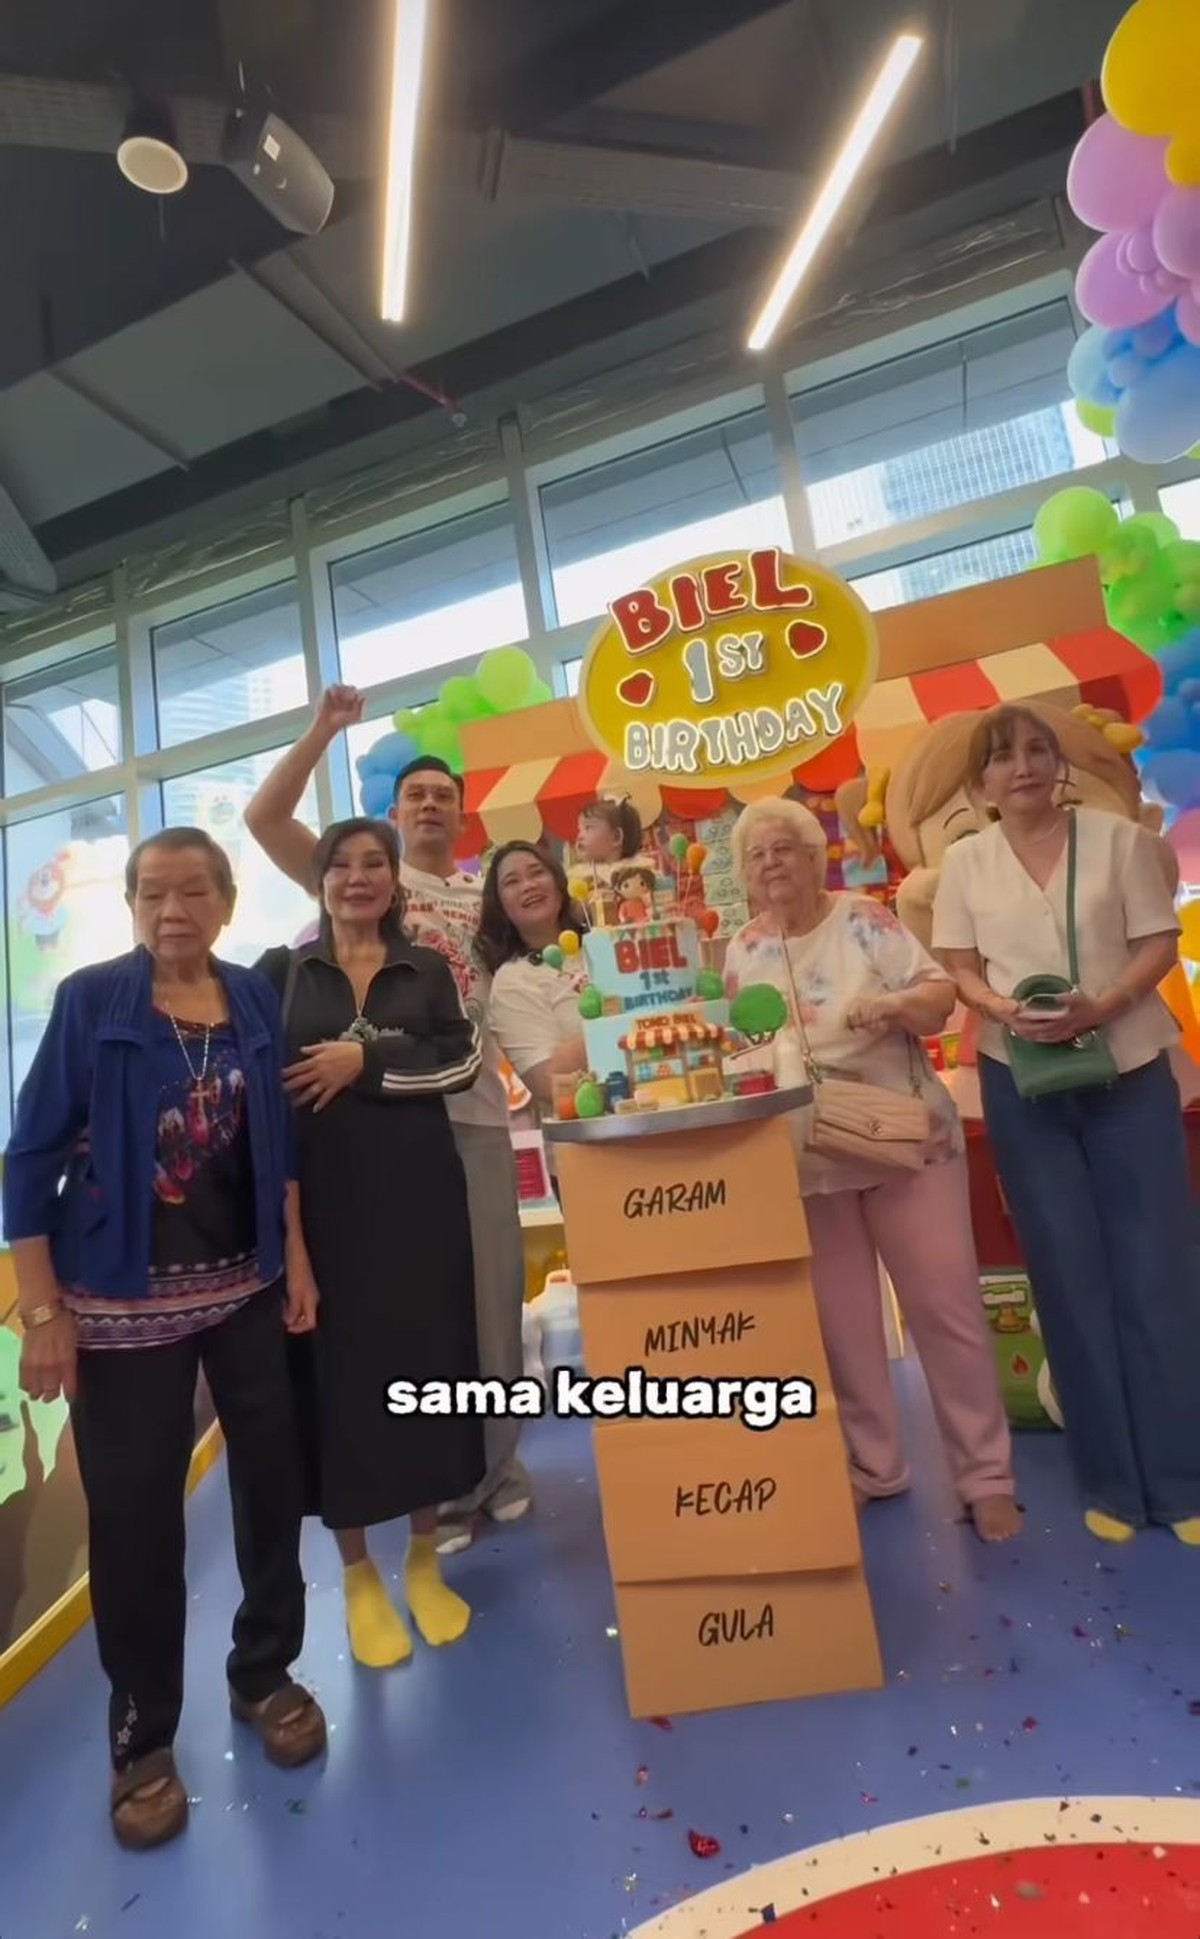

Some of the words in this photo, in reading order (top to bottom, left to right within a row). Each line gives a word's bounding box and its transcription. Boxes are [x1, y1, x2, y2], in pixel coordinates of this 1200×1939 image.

[610, 547, 813, 654] BIEL
[624, 683, 844, 772] BIRTHDAY
[614, 936, 688, 974] BIEL
[624, 986, 692, 1011] BIRTHDAY
[623, 1179, 726, 1219] GARAM
[644, 1311, 756, 1357] MINYAK
[675, 1477, 777, 1518] KECAP
[698, 1604, 774, 1647] GULA
